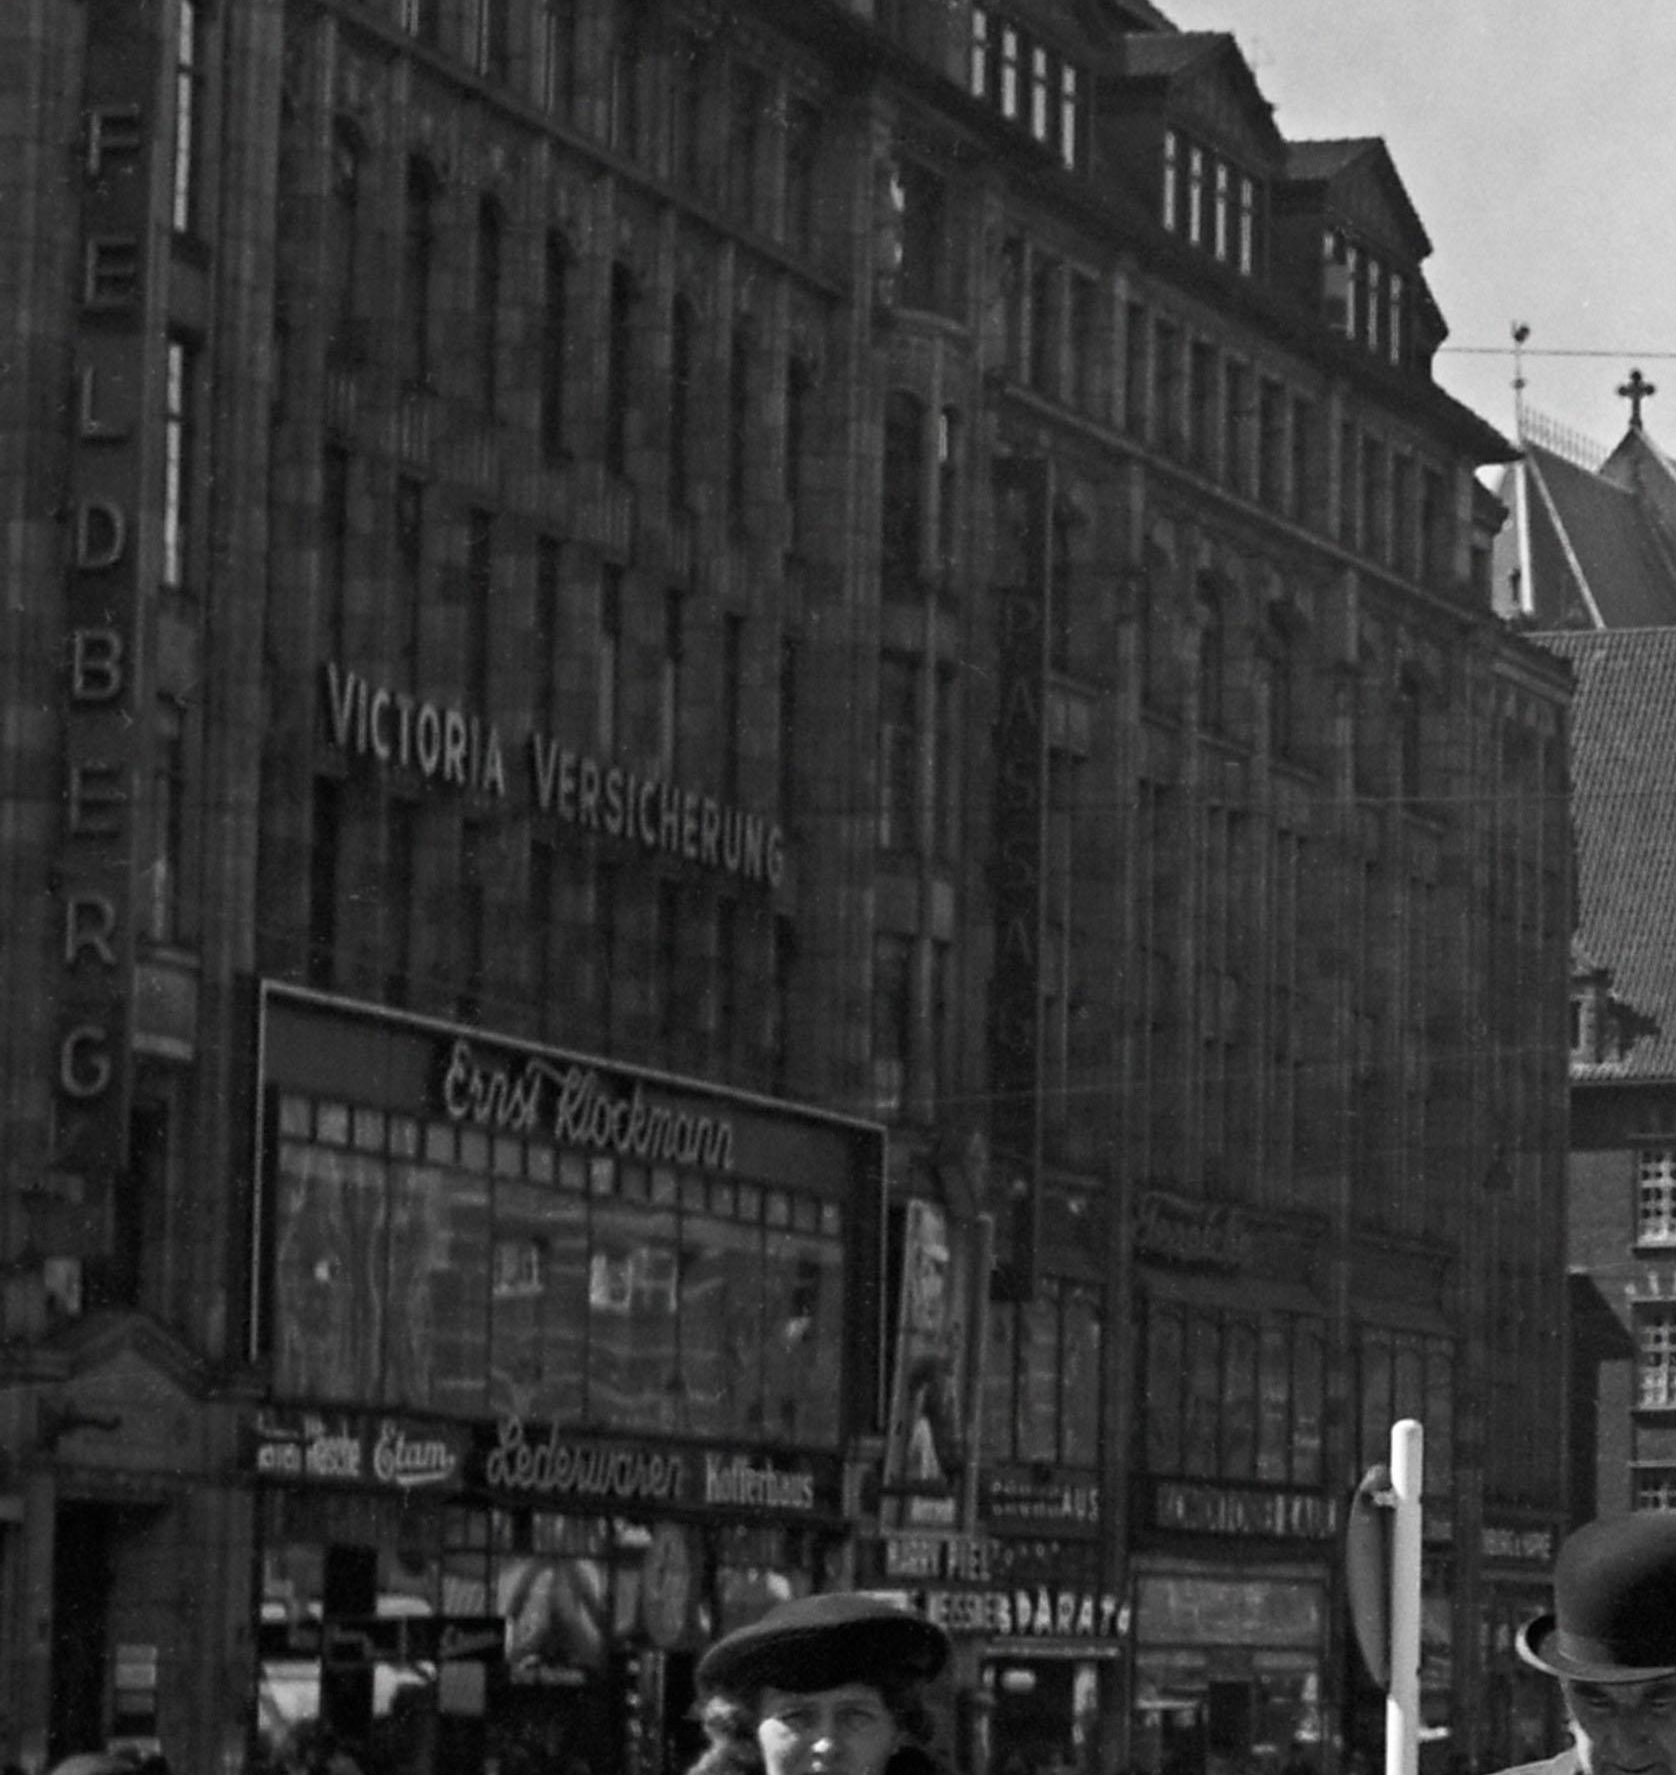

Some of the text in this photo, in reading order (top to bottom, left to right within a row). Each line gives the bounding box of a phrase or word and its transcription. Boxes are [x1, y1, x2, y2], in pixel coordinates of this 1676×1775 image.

[60, 106, 141, 1098] FELDBERG
[328, 663, 784, 885] VICTORIA VERSICHERUNG
[444, 1037, 560, 1131] Ernst
[486, 1417, 814, 1508] Lederwaren Kofferhaus
